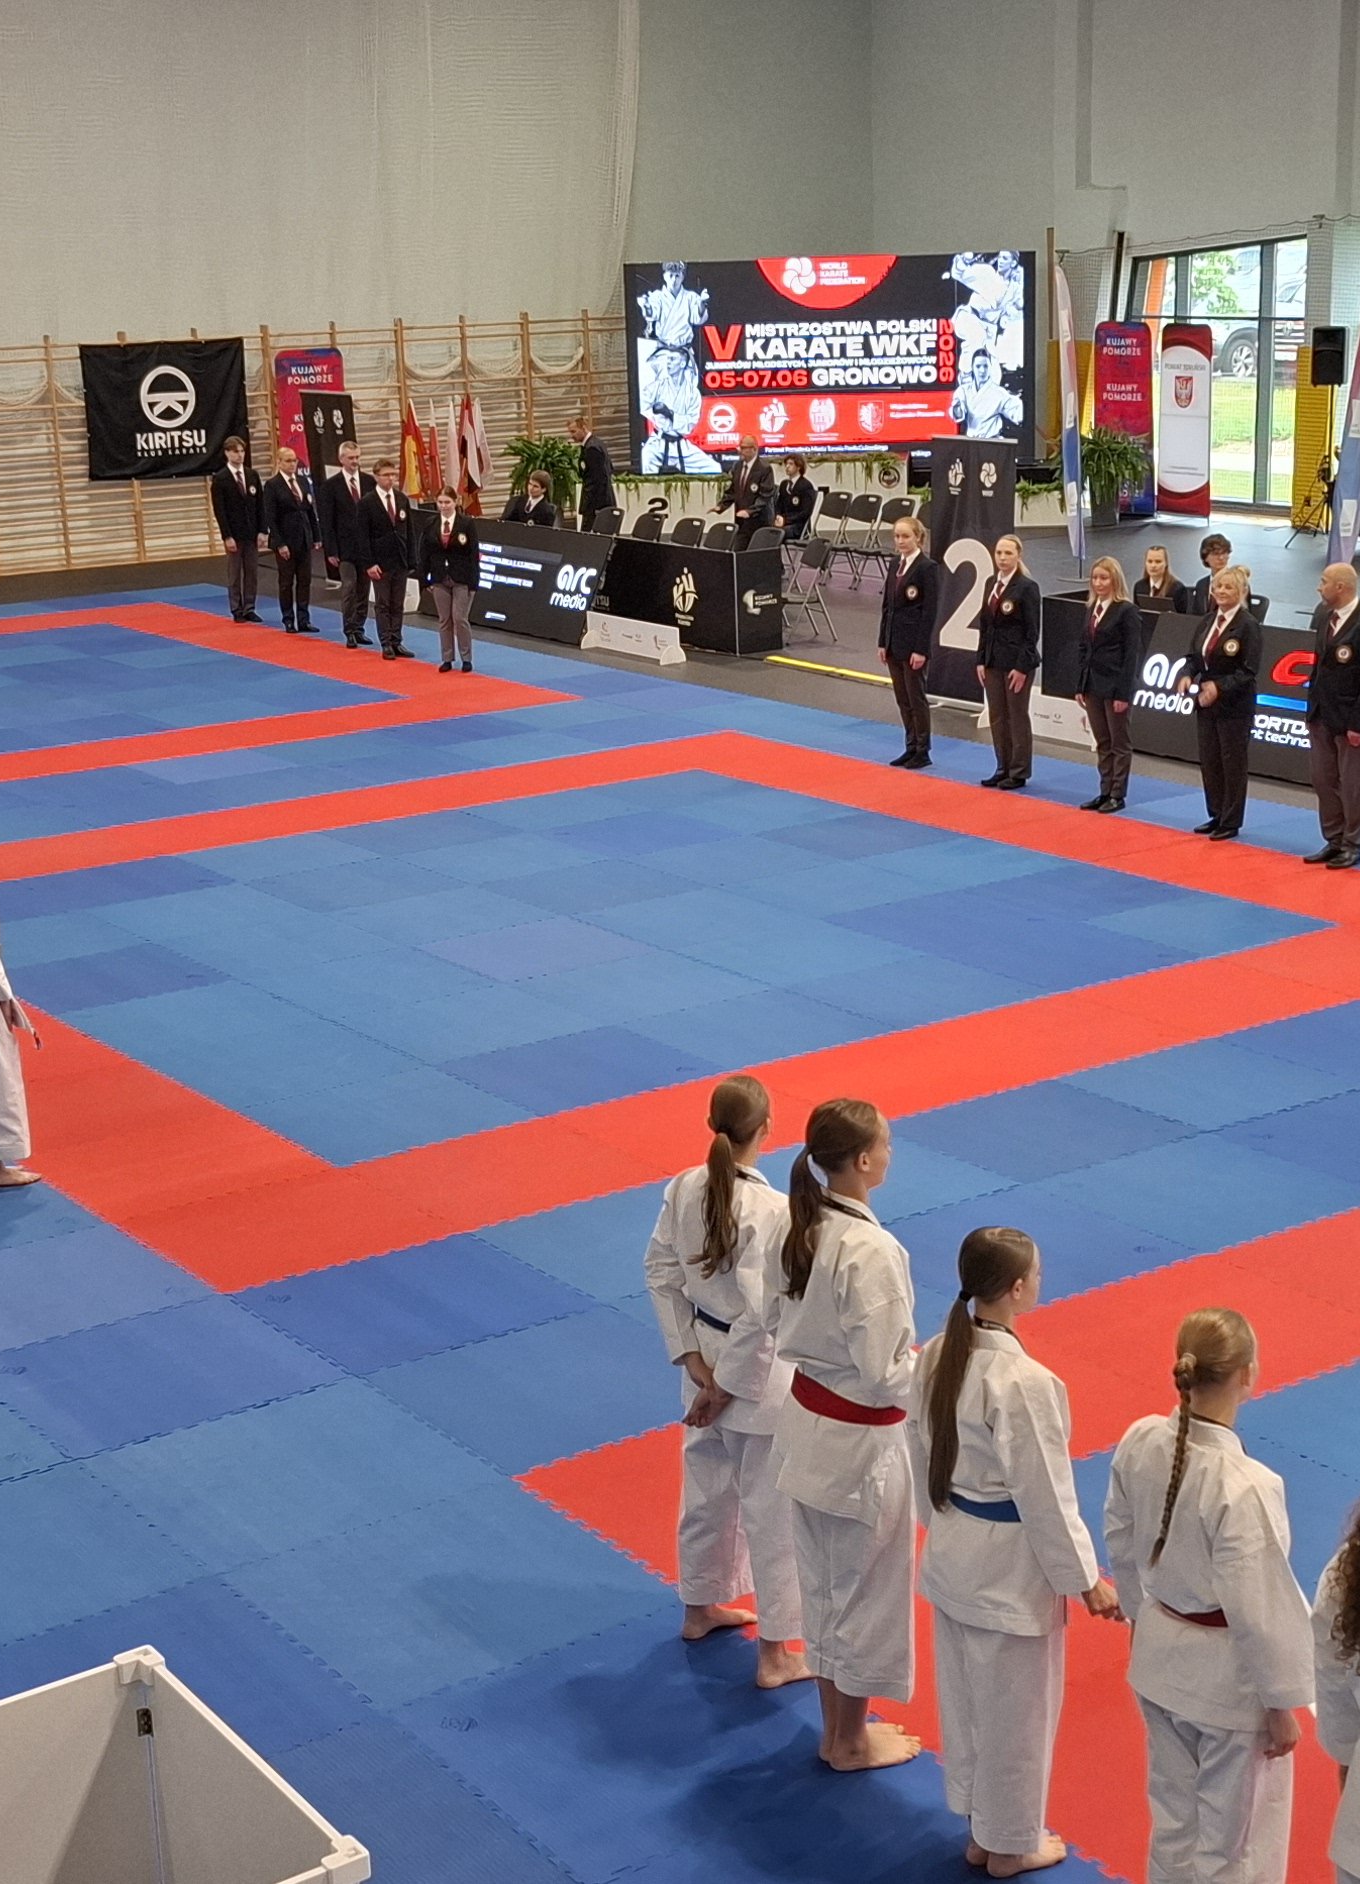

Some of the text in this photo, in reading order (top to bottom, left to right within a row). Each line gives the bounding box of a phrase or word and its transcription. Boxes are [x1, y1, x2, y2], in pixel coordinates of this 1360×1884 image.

[745, 319, 938, 338] MISTRZOSTWA POLSKI
[704, 324, 742, 361] V
[745, 334, 938, 360] KARATE WKF
[939, 319, 955, 383] 2026
[1103, 347, 1142, 356] POMORZE
[1106, 338, 1138, 346] KUJAWY
[287, 374, 333, 385] POMORZE
[291, 365, 328, 375] KUJAWY
[705, 365, 938, 389] 05-07.06 GRONOWO
[1103, 393, 1142, 402] POMORZE
[1106, 384, 1138, 392] KUJAWY
[136, 429, 206, 450] KIRITSU
[557, 564, 598, 595] arc
[549, 592, 588, 611] media
[939, 538, 995, 651] 2
[1133, 689, 1195, 715] media
